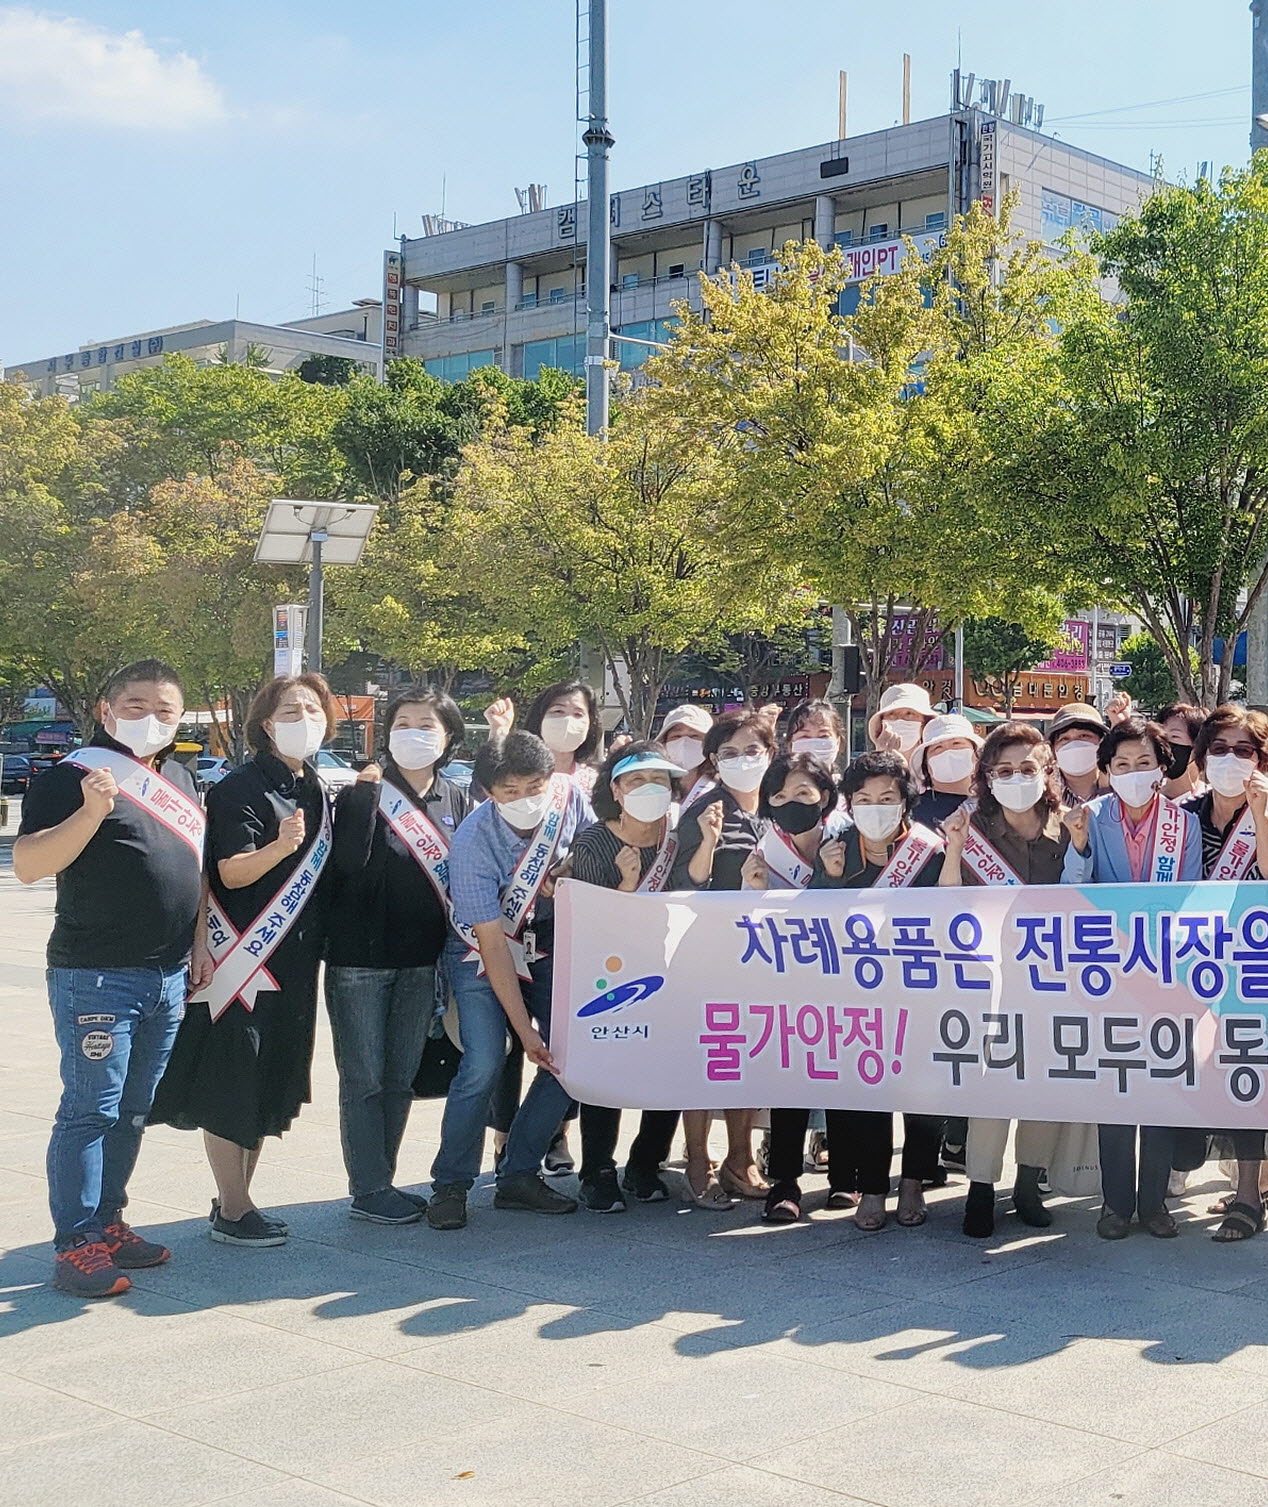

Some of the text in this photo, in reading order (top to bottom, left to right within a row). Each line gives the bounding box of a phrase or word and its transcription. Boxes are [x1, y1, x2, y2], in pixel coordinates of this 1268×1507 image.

[398, 811, 444, 862] 물가안정
[542, 811, 560, 842] 함께
[519, 842, 552, 888] 동참해
[886, 836, 928, 888] 물가안정
[1219, 839, 1251, 881] 물가안
[243, 839, 329, 958] 함께 동참해 주세요
[502, 885, 528, 923] 주세요
[206, 906, 231, 950] 세요
[739, 912, 995, 991] 차례용품은
[591, 1023, 650, 1040] 안산시
[699, 1003, 909, 1085] 물가안정!
[931, 1008, 1025, 1087] 우리
[1047, 1015, 1196, 1087] 모두의
